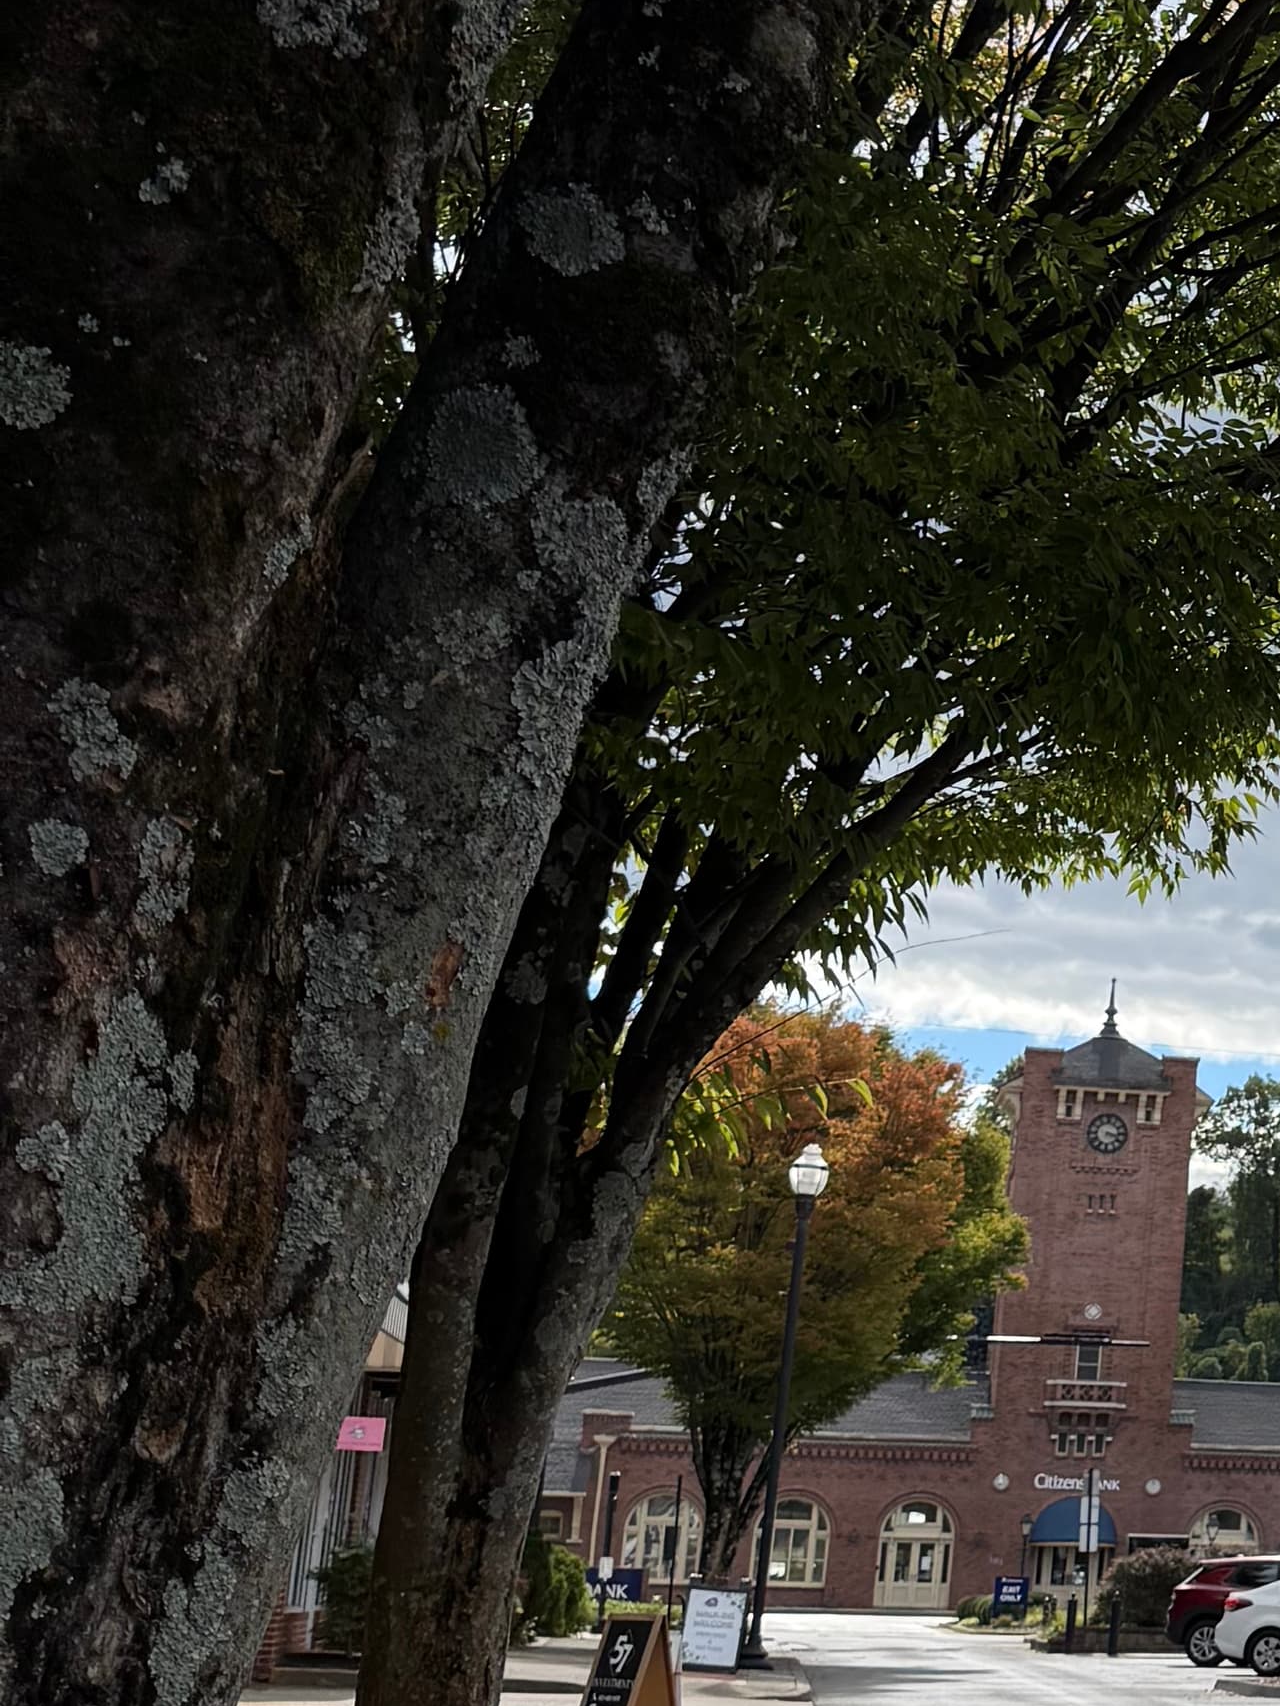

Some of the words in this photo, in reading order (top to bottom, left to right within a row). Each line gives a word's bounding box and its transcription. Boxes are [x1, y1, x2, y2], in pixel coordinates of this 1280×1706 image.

[1034, 1473, 1084, 1491] Citizens
[585, 1583, 628, 1599] ANK
[609, 1635, 634, 1672] 57
